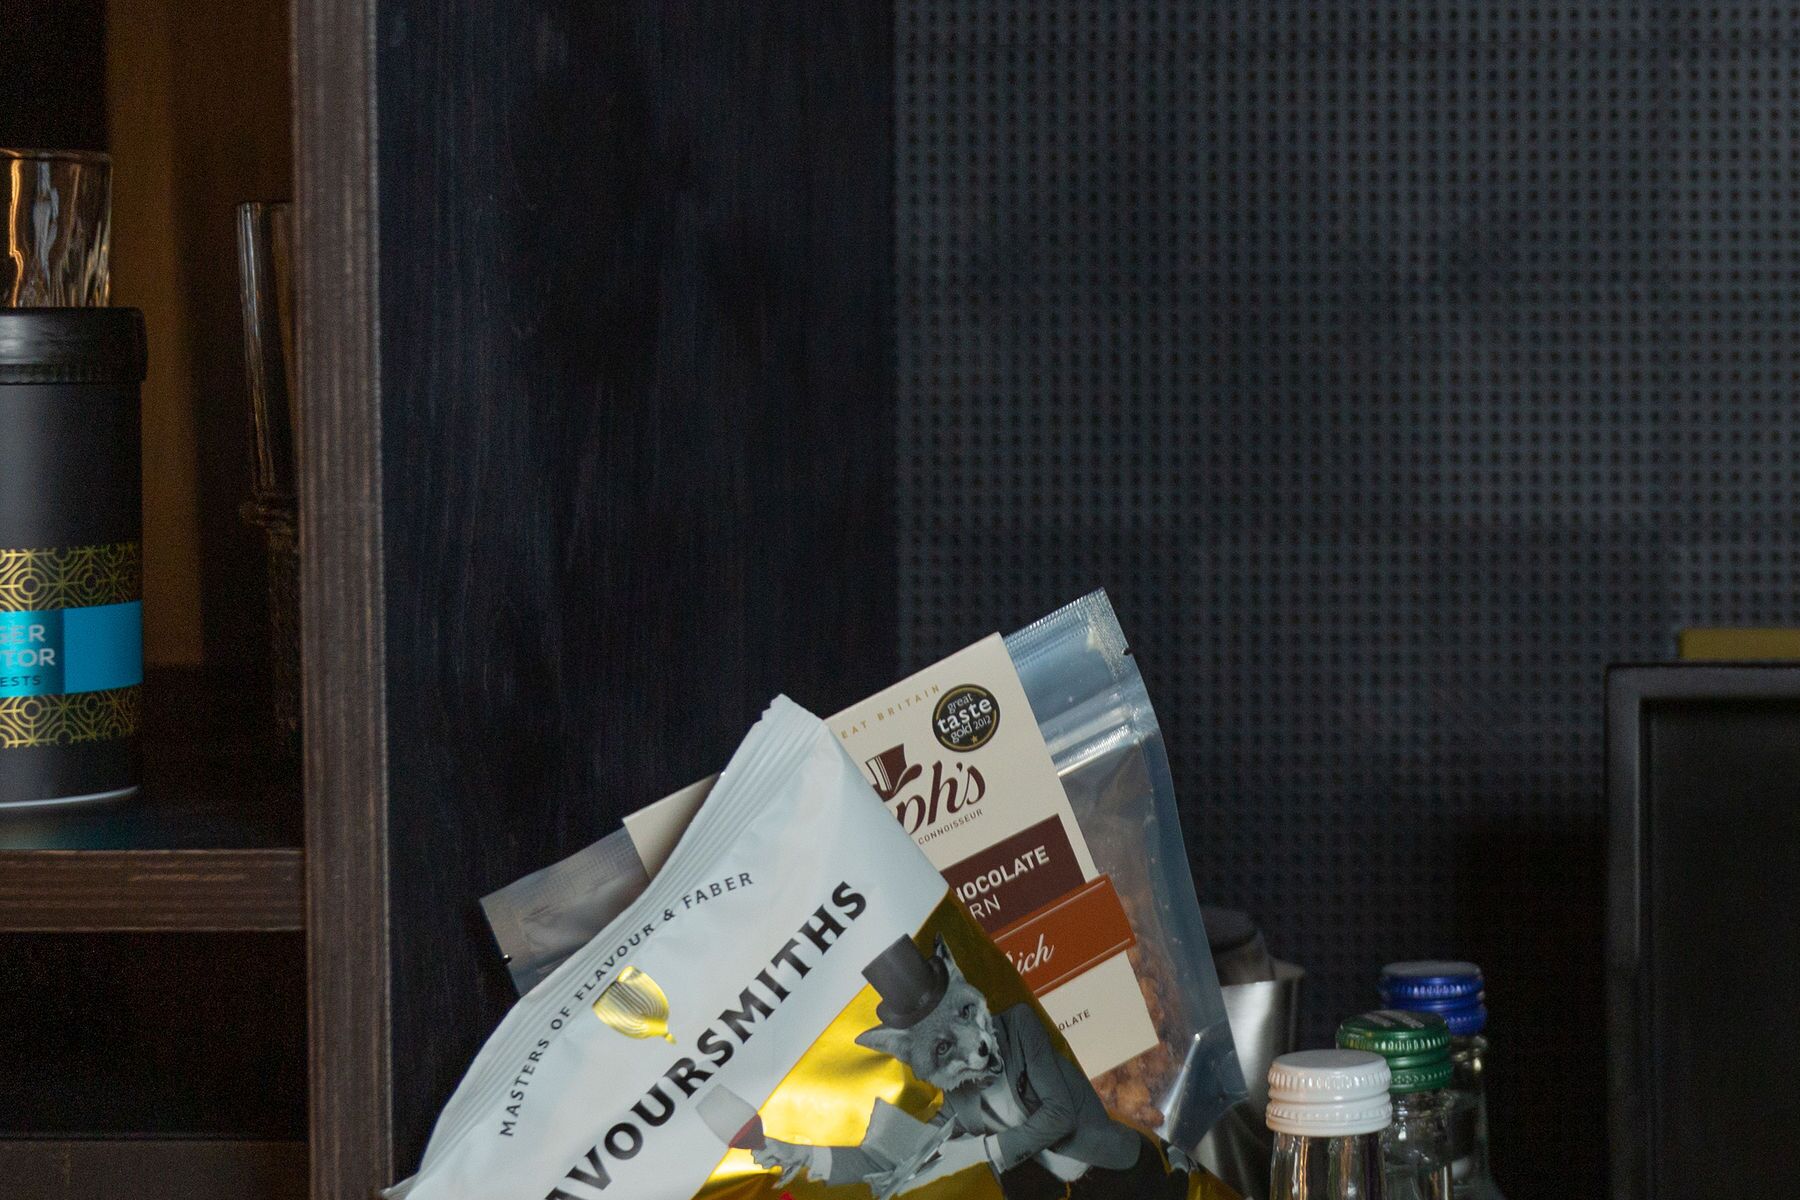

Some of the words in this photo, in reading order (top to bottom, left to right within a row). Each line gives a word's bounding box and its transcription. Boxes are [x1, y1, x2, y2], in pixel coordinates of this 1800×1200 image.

[876, 683, 941, 721] BRITAIN
[937, 698, 992, 733] taste
[947, 693, 973, 714] great
[951, 721, 973, 743] gold
[973, 714, 992, 730] 2012
[918, 808, 984, 845] CONNOISSEUR
[499, 1039, 550, 1137] MASTERS
[550, 1006, 571, 1031] OF
[575, 923, 656, 1002] FLAVOUR
[663, 908, 676, 922] &
[682, 872, 754, 909] FABER
